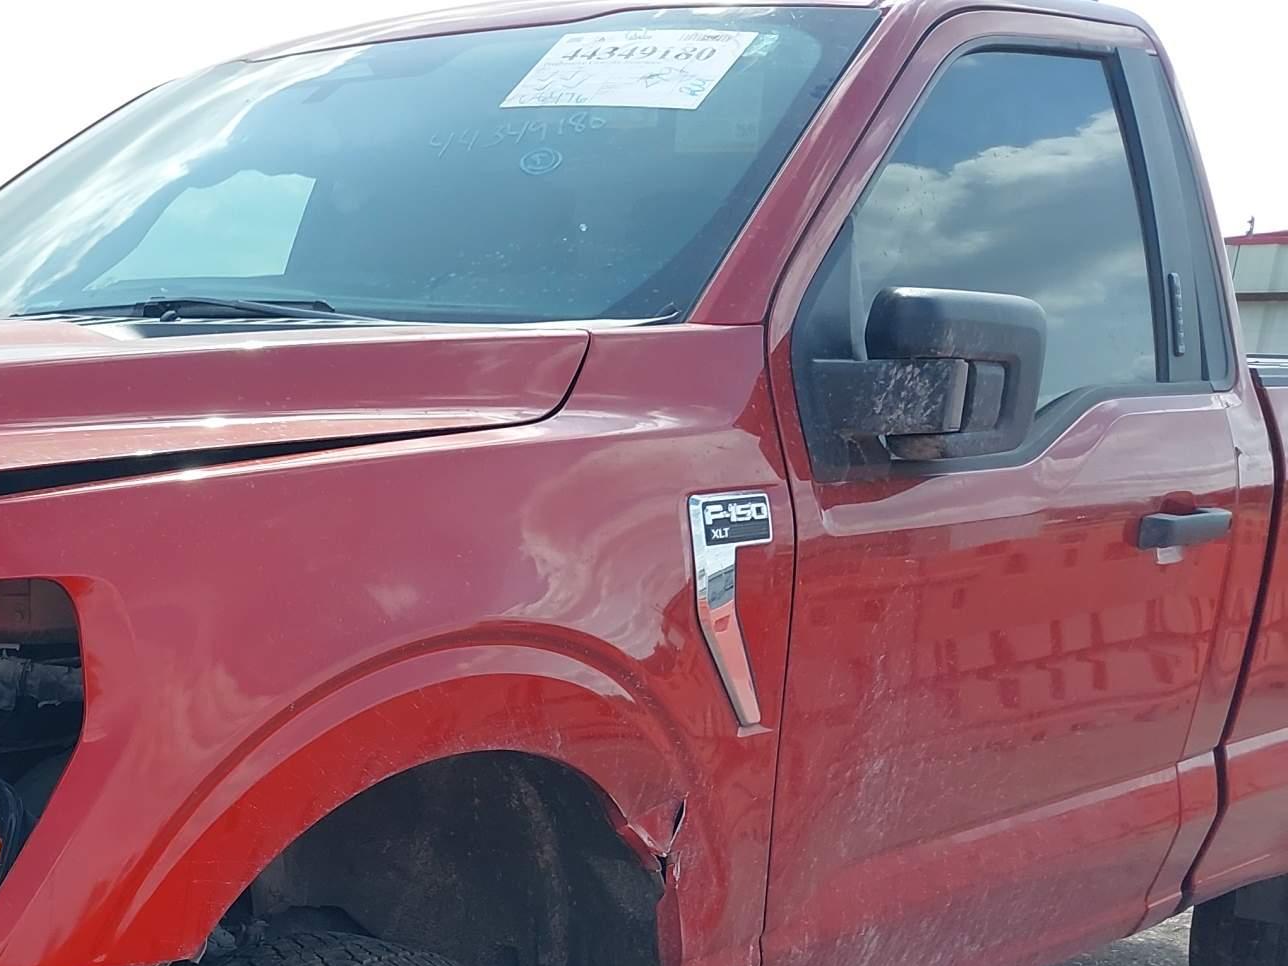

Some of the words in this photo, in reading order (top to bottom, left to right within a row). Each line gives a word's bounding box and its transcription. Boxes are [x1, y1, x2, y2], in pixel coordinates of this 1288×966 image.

[561, 45, 718, 62] 44349180
[704, 502, 768, 525] F-150
[711, 527, 730, 539] XLT
